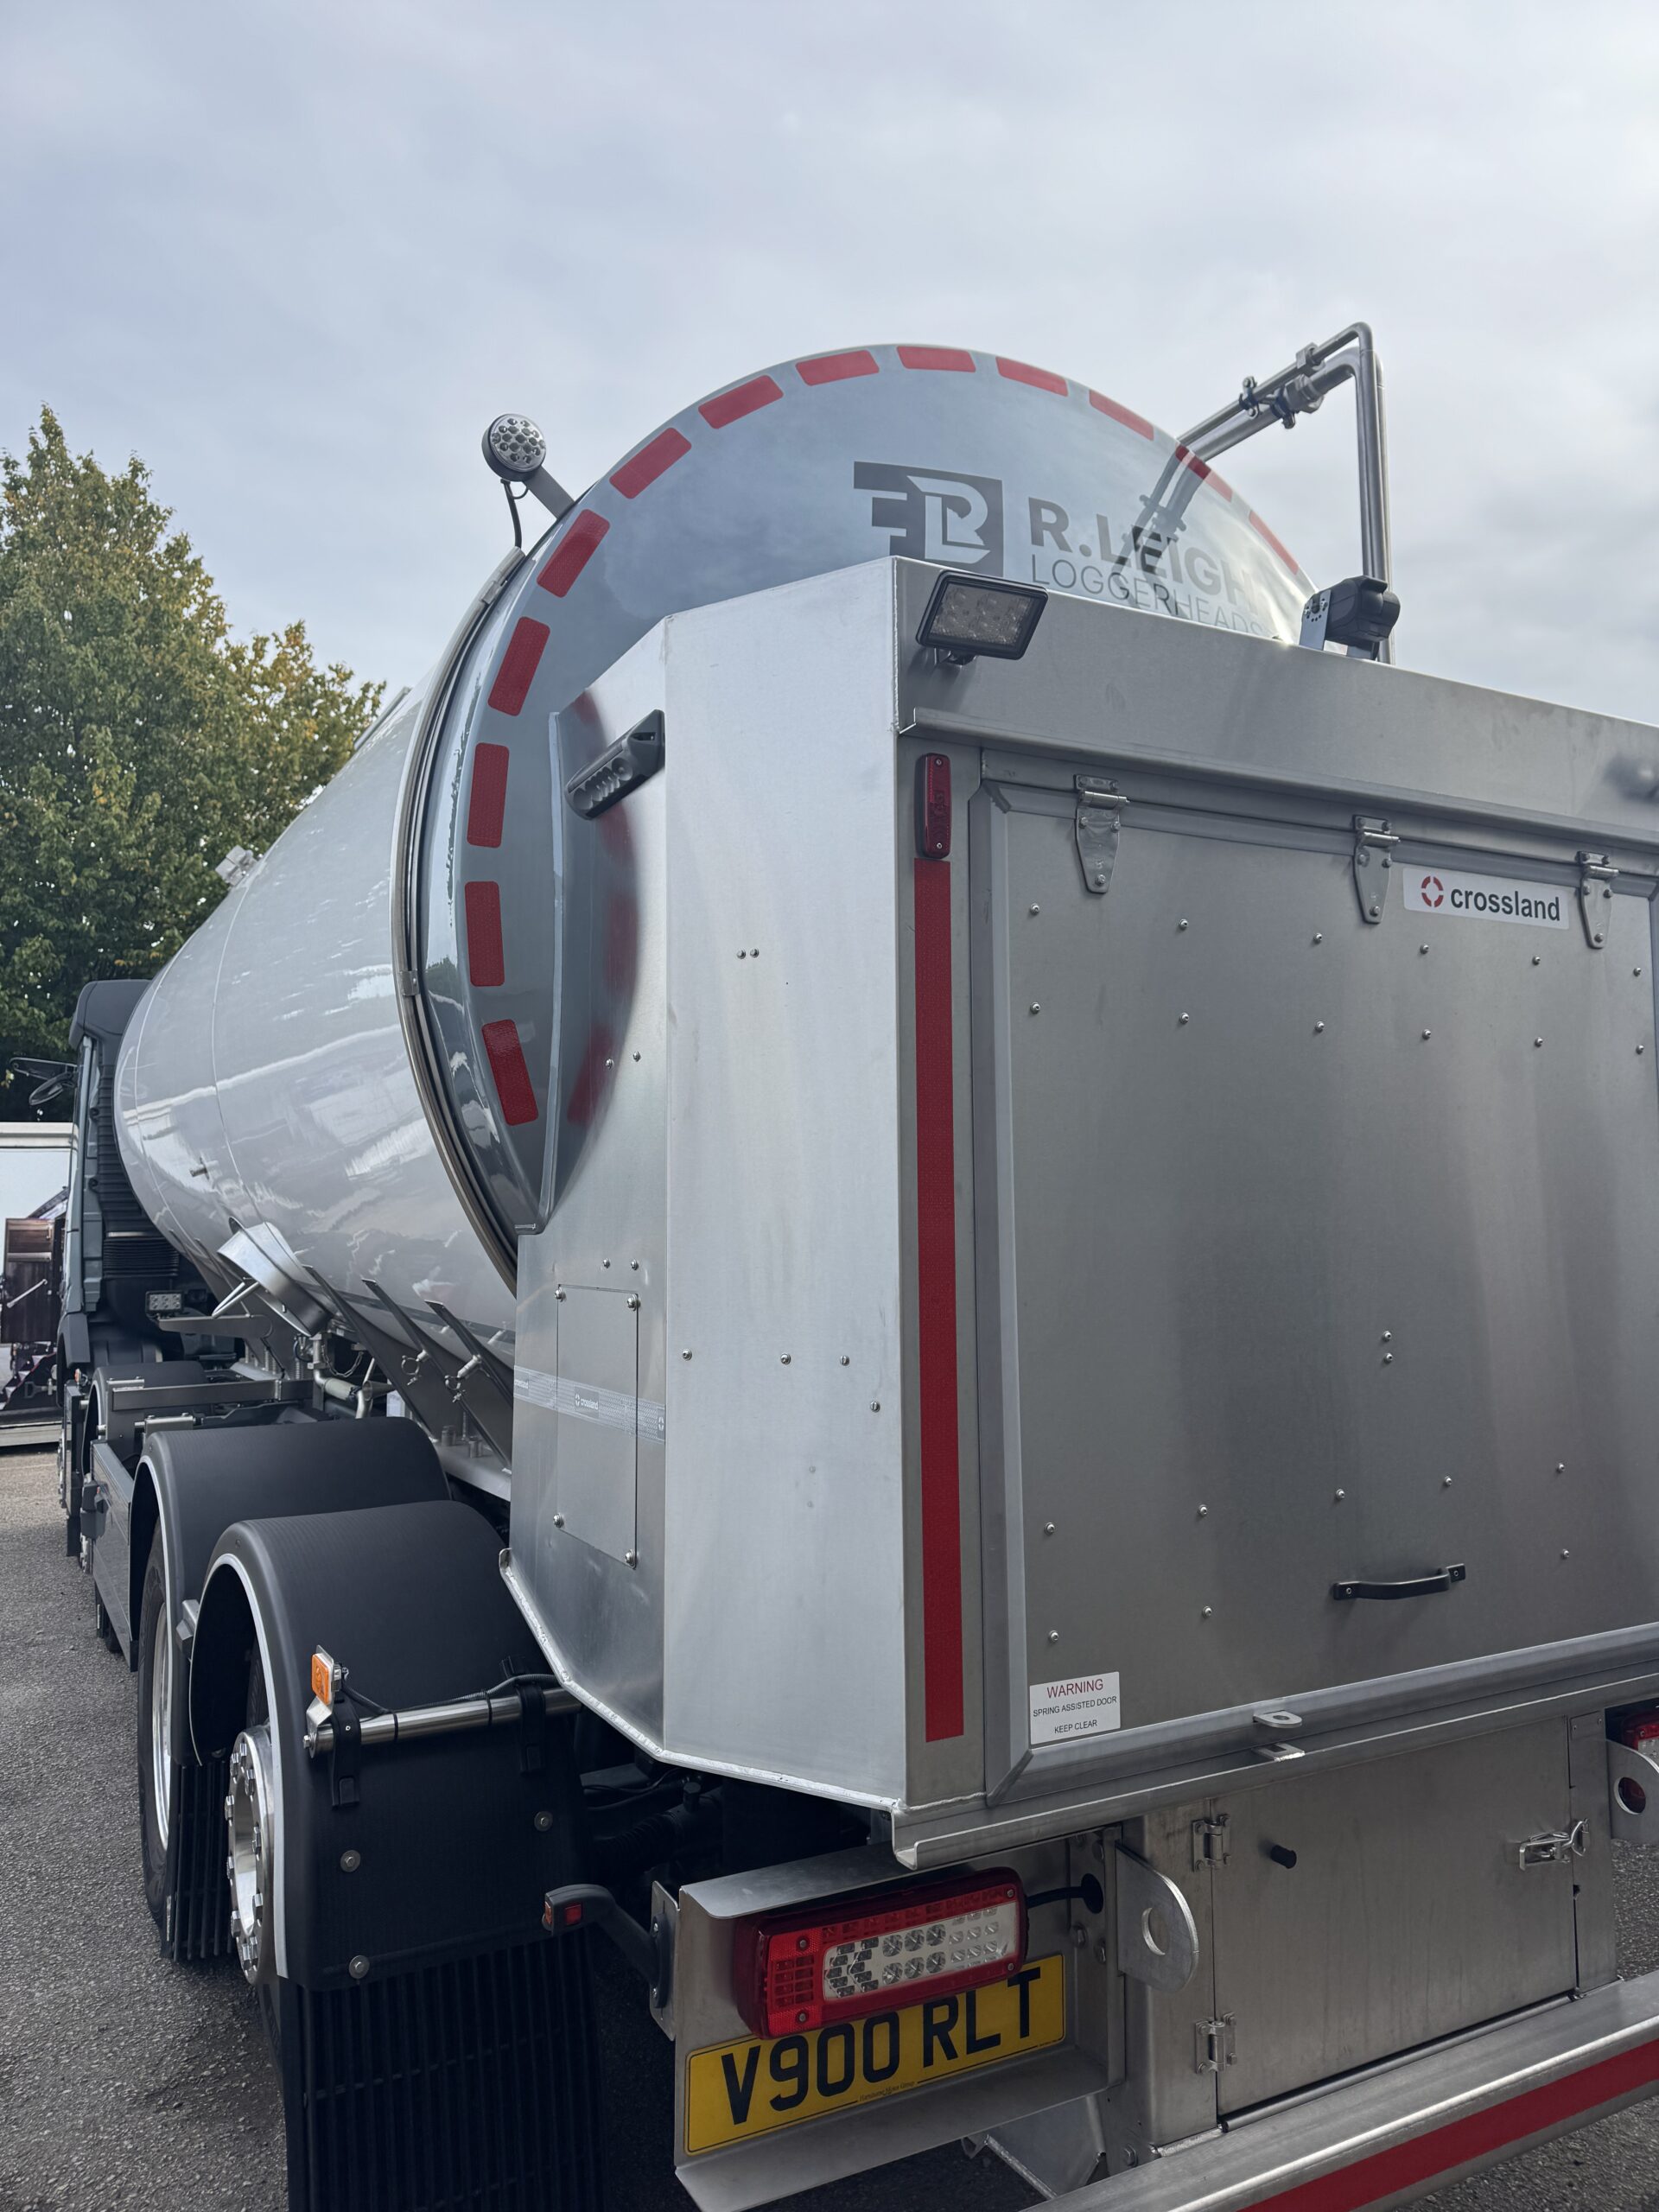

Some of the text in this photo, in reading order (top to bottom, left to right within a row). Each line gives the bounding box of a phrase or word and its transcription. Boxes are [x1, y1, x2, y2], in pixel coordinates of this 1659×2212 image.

[1028, 497, 1258, 615] R.LEIGH
[1450, 888, 1560, 921] crossland
[1046, 1678, 1103, 1699] WARNING
[1033, 1695, 1117, 1718] SPRING ASSISTED DOOR
[1054, 1719, 1097, 1734] KEEP CLEAR
[721, 1967, 1041, 2126] V900 RLT
